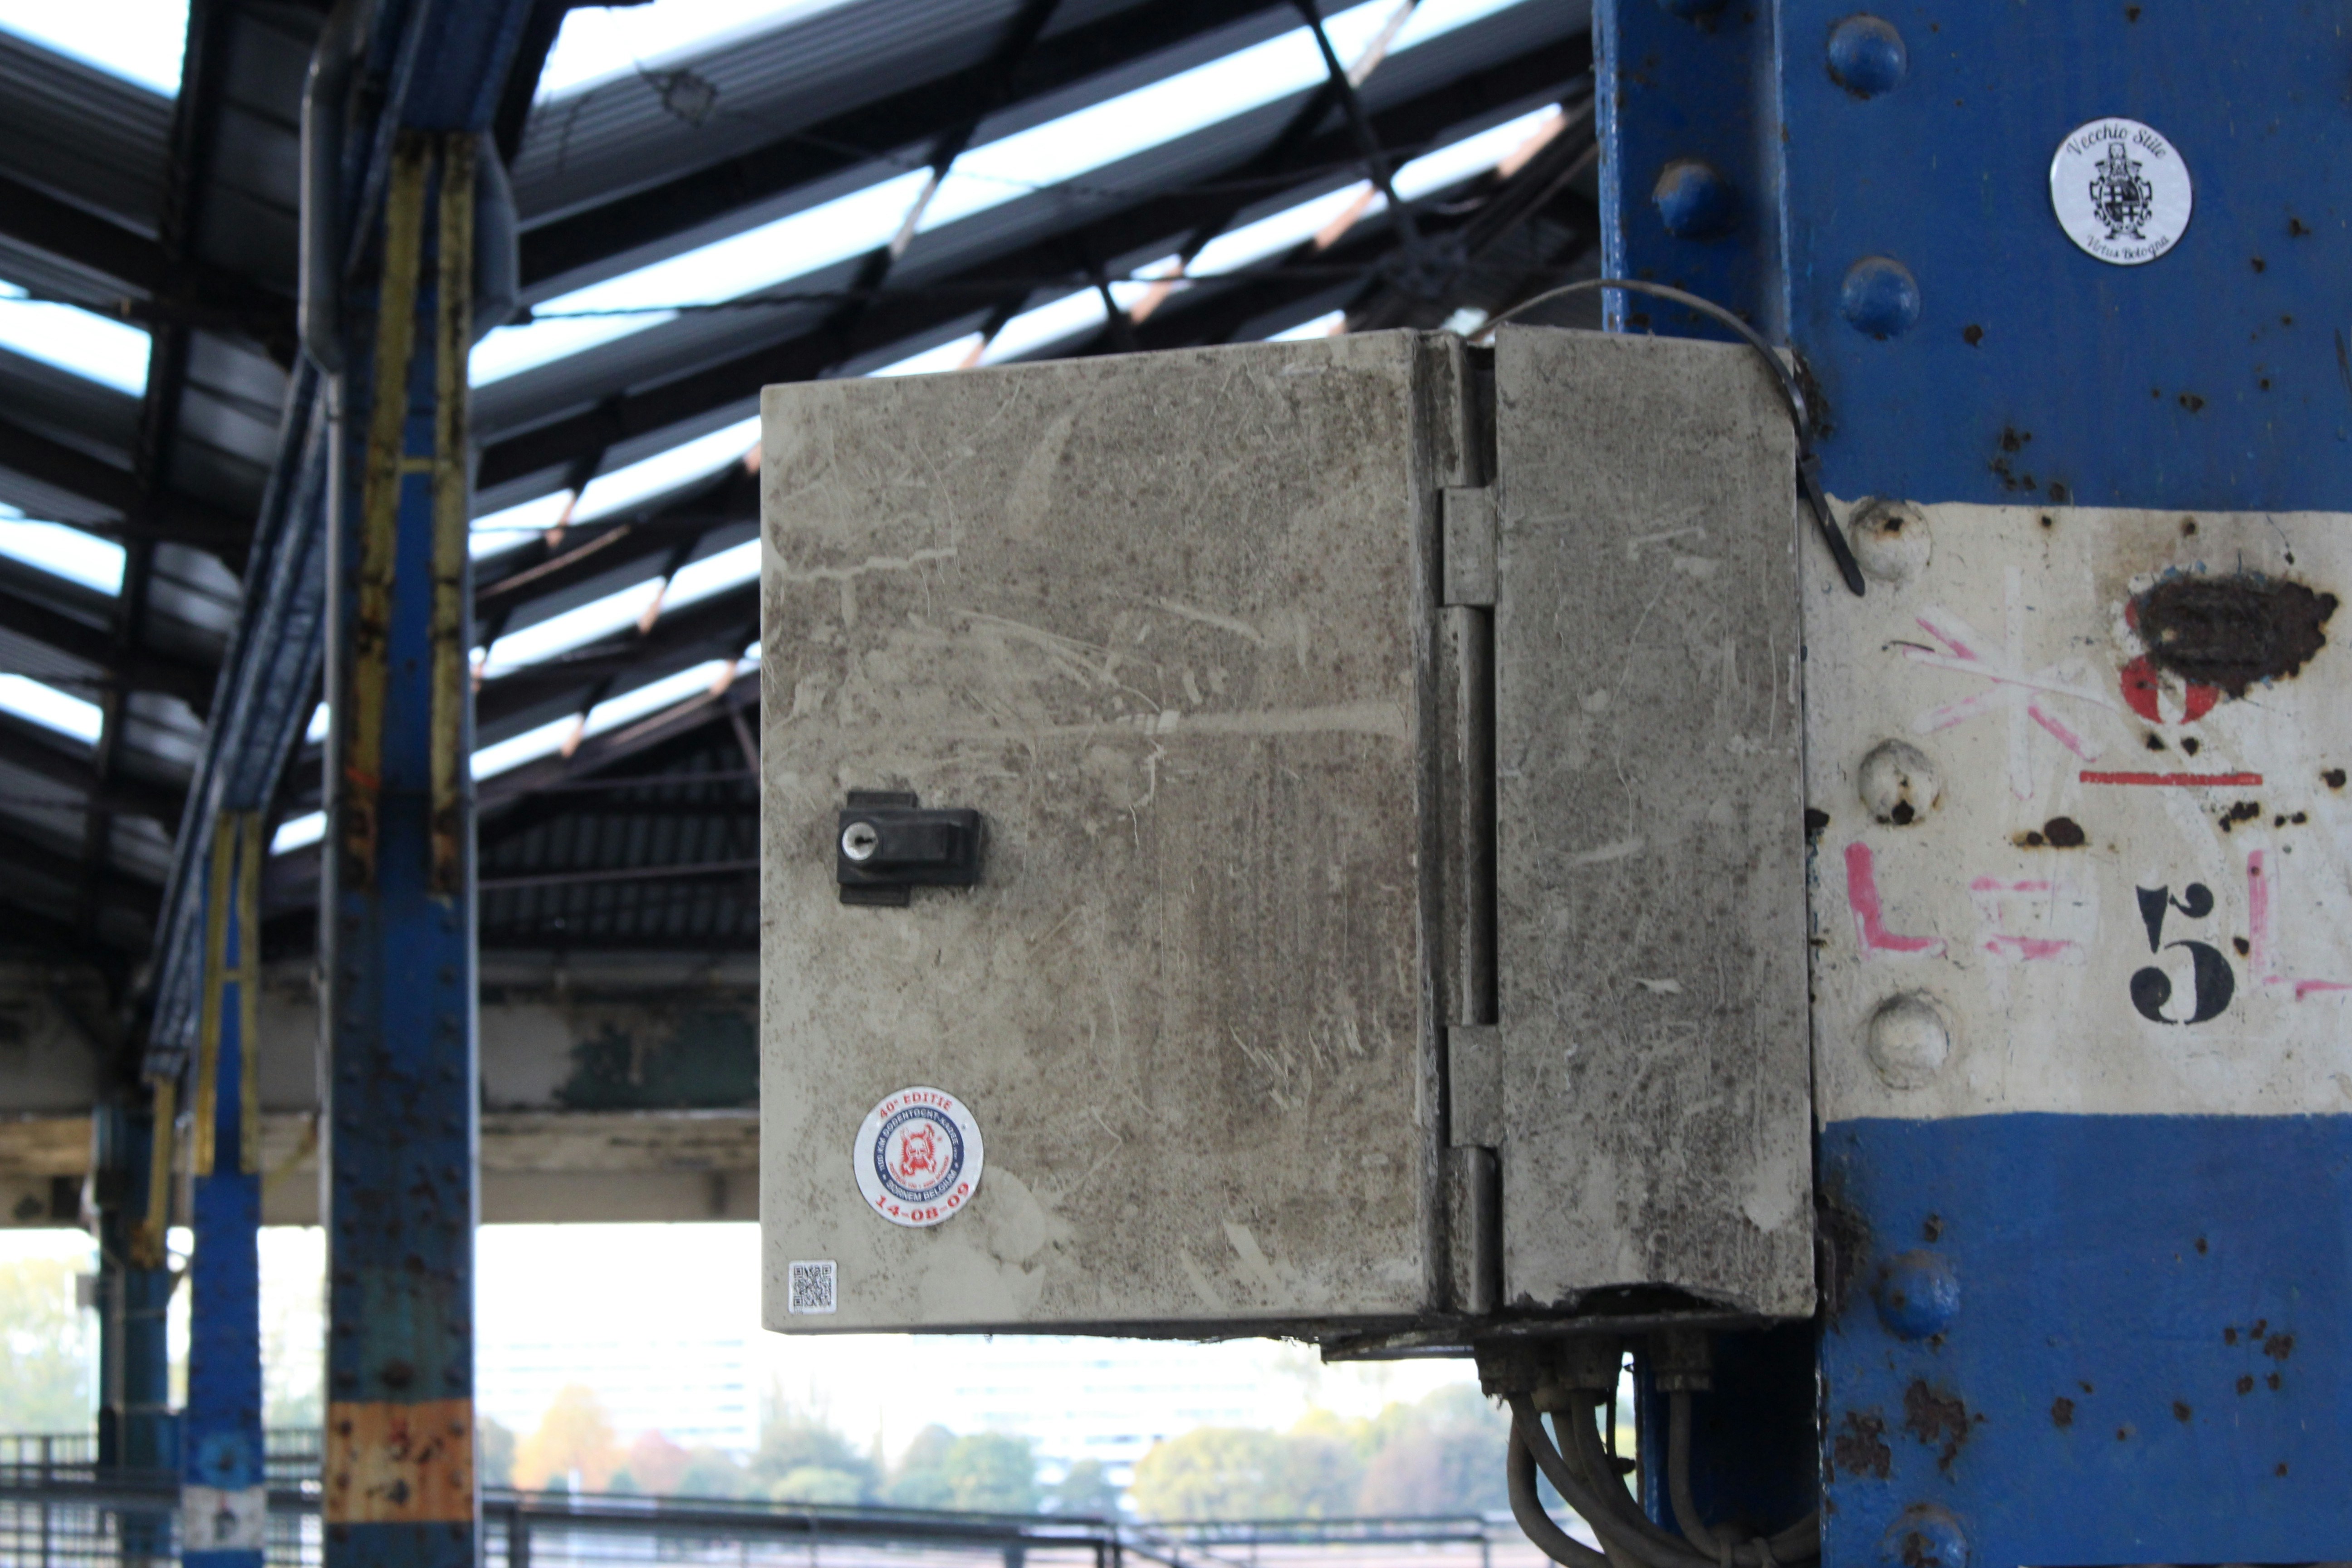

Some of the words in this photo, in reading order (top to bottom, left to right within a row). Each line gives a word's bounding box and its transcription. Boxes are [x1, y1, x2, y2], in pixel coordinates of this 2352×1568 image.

[2066, 123, 2128, 156] Vecchio
[2133, 127, 2166, 158] Stile
[2087, 234, 2119, 258] Virtus
[2124, 235, 2170, 260] Bologna
[2130, 882, 2235, 1025] 5
[903, 1092, 952, 1112] EDITIE
[877, 1137, 886, 1154] KM
[875, 1181, 970, 1221] 14-08-09
[886, 1179, 921, 1202] BORNEM
[924, 1169, 957, 1200] BELGIUM
